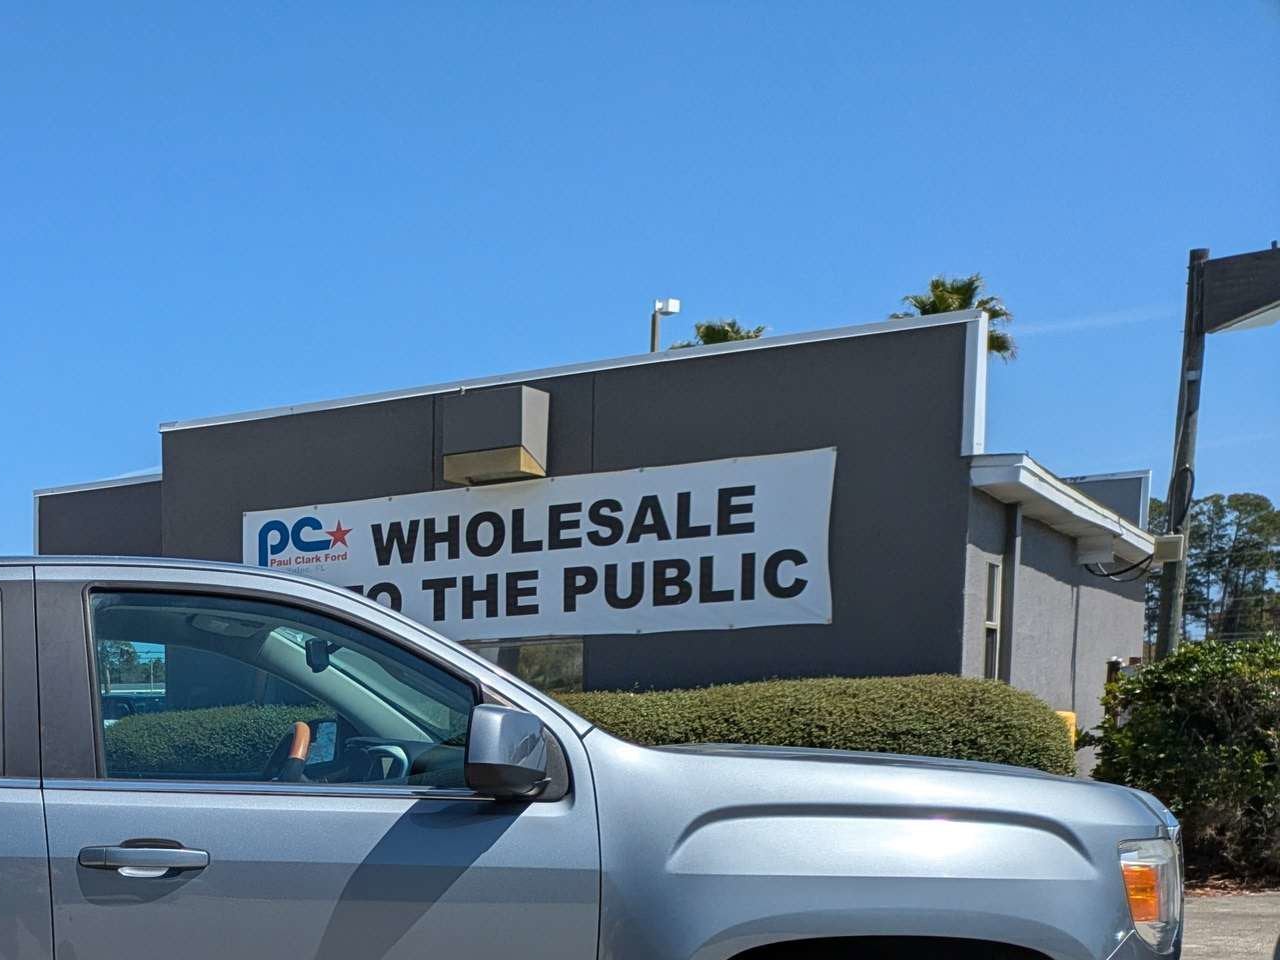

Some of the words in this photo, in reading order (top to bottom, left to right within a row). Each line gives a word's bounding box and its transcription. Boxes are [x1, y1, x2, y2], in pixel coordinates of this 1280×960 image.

[270, 556, 291, 567] Paul
[295, 554, 321, 564] Clark
[324, 552, 348, 562] Ford
[371, 485, 756, 566] WHOLESALE
[344, 582, 402, 614] O
[425, 571, 539, 622] THE
[563, 549, 809, 613] PUBLIC
